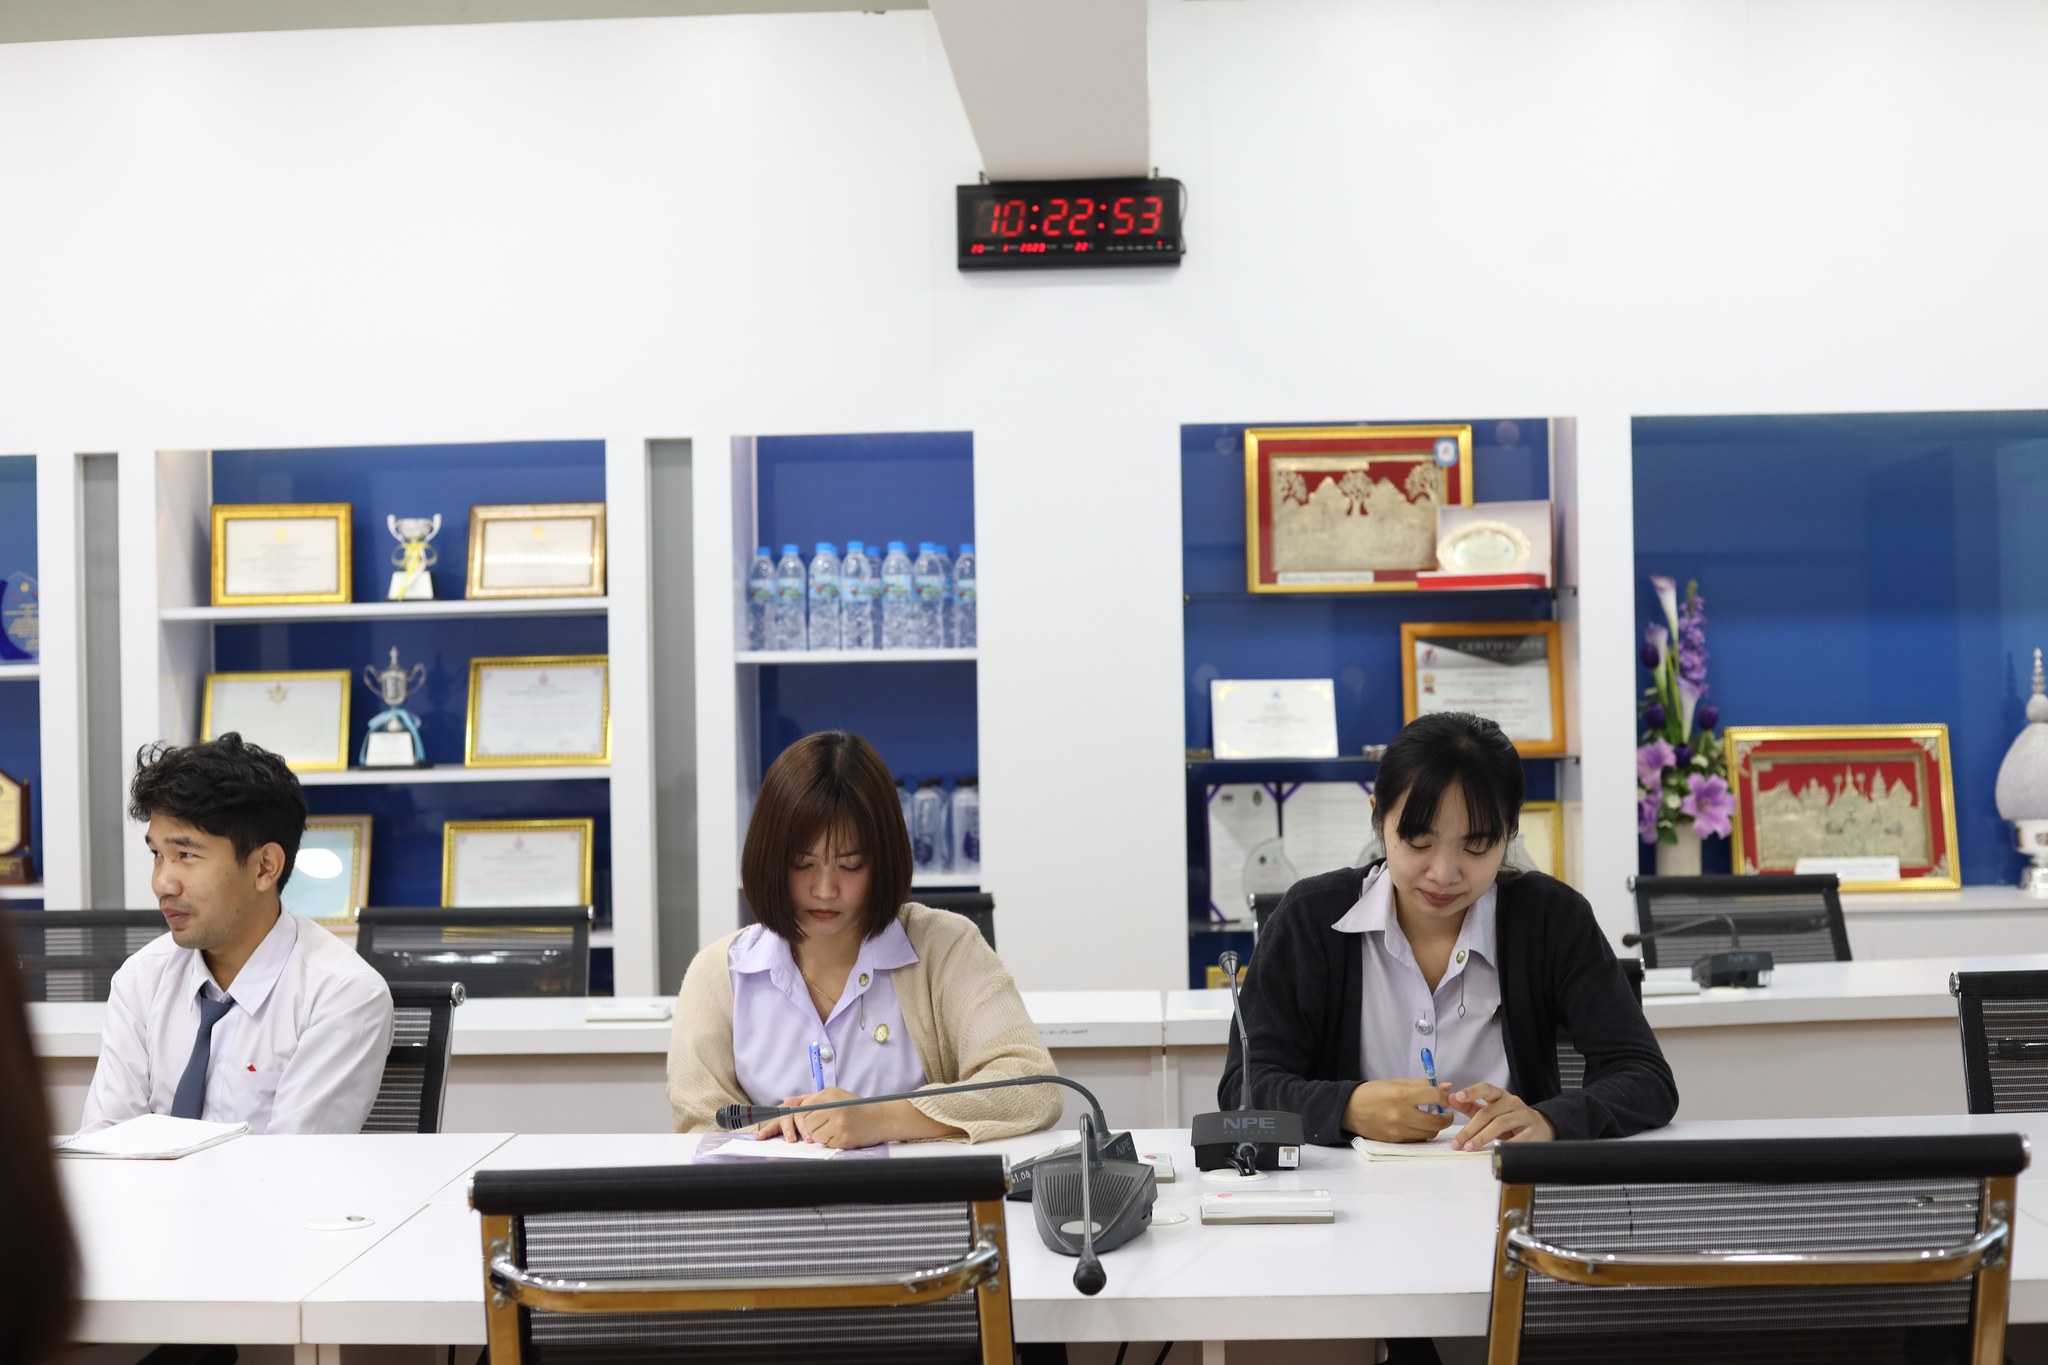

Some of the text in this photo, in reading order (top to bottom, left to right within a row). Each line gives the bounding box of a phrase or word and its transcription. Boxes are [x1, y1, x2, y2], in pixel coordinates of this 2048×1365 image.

[990, 196, 1163, 237] 10:22:53
[1223, 1117, 1276, 1129] NPE
[1115, 1139, 1131, 1157] NPE
